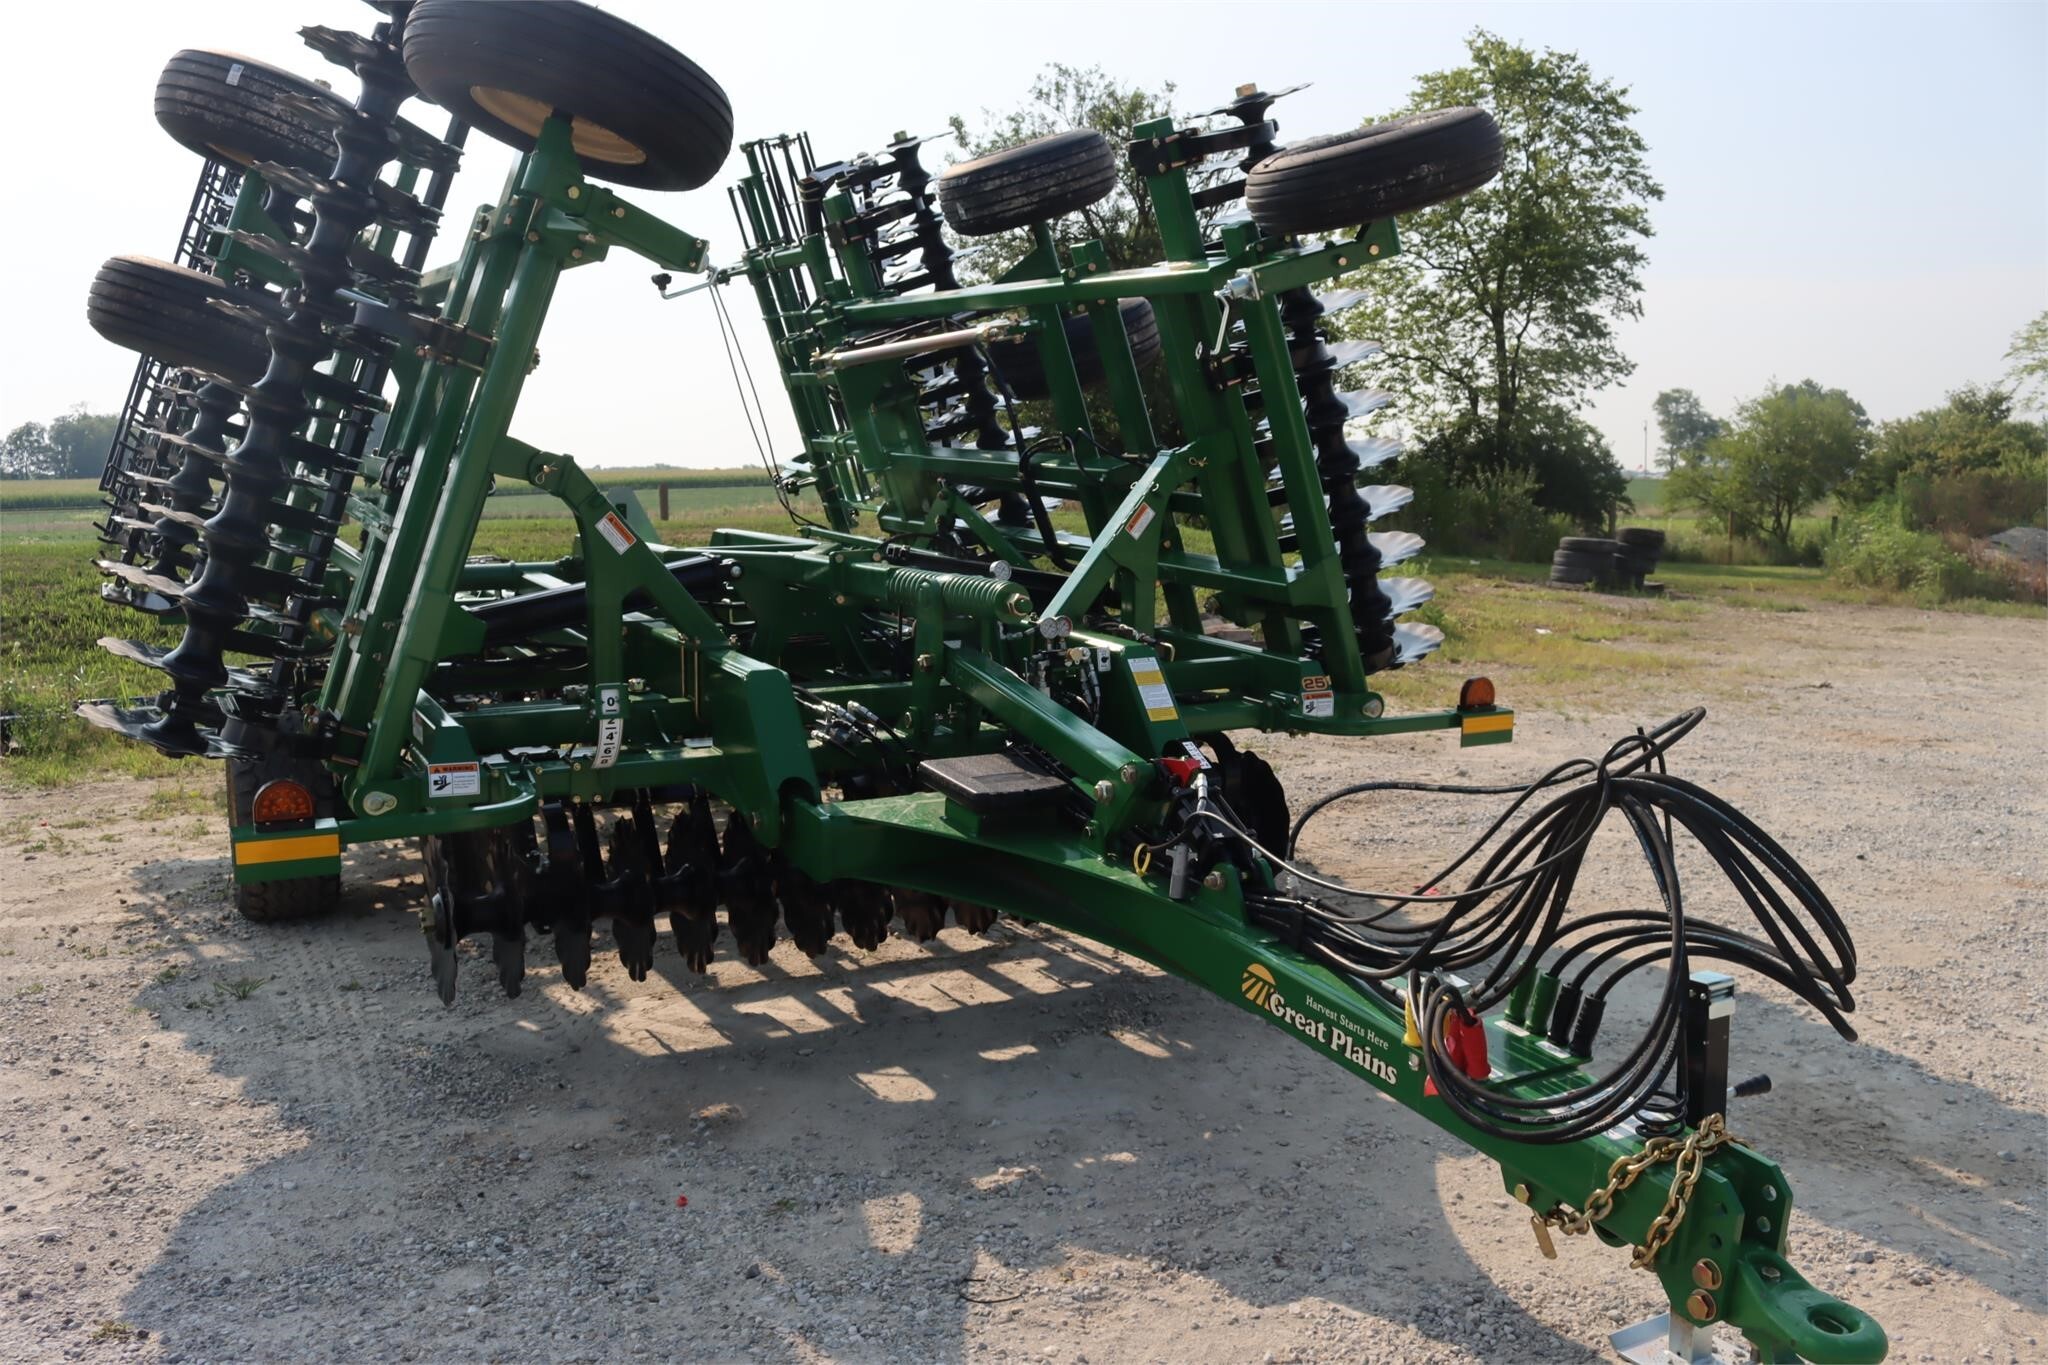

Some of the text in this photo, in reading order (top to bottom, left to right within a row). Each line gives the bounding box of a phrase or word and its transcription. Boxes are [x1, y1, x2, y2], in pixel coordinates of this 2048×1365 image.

[1303, 677, 1327, 690] 25
[1269, 993, 1398, 1085] Great Plains
[1305, 994, 1389, 1051] Harvest Starts Here
